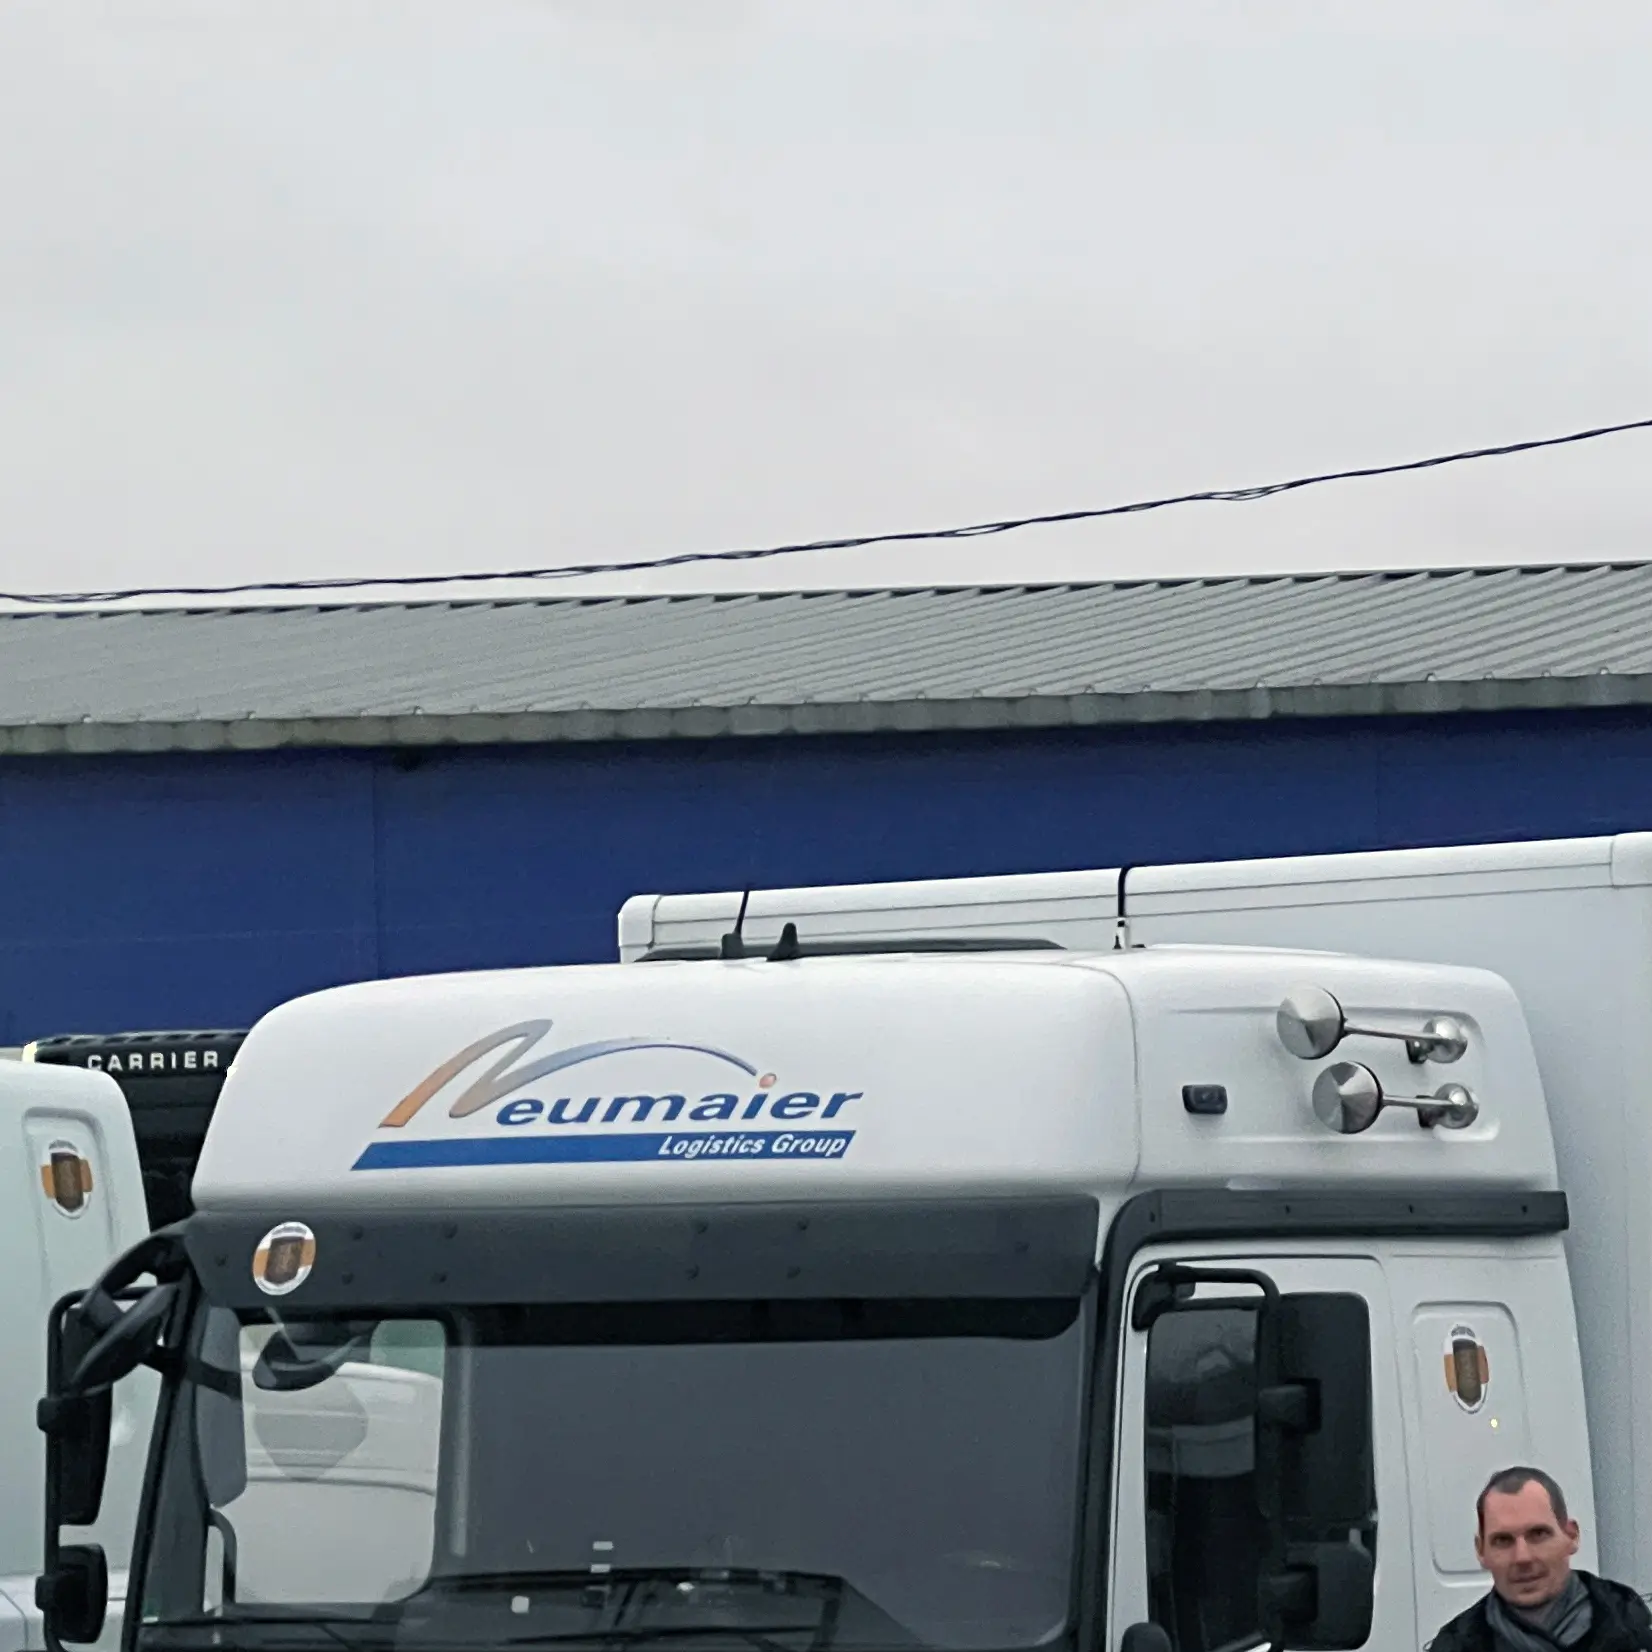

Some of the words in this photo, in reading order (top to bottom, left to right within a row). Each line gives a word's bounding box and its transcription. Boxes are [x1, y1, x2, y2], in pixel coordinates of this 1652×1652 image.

[87, 1050, 219, 1071] CARRIER
[658, 1134, 765, 1160] Logistics
[771, 1130, 848, 1157] Group
